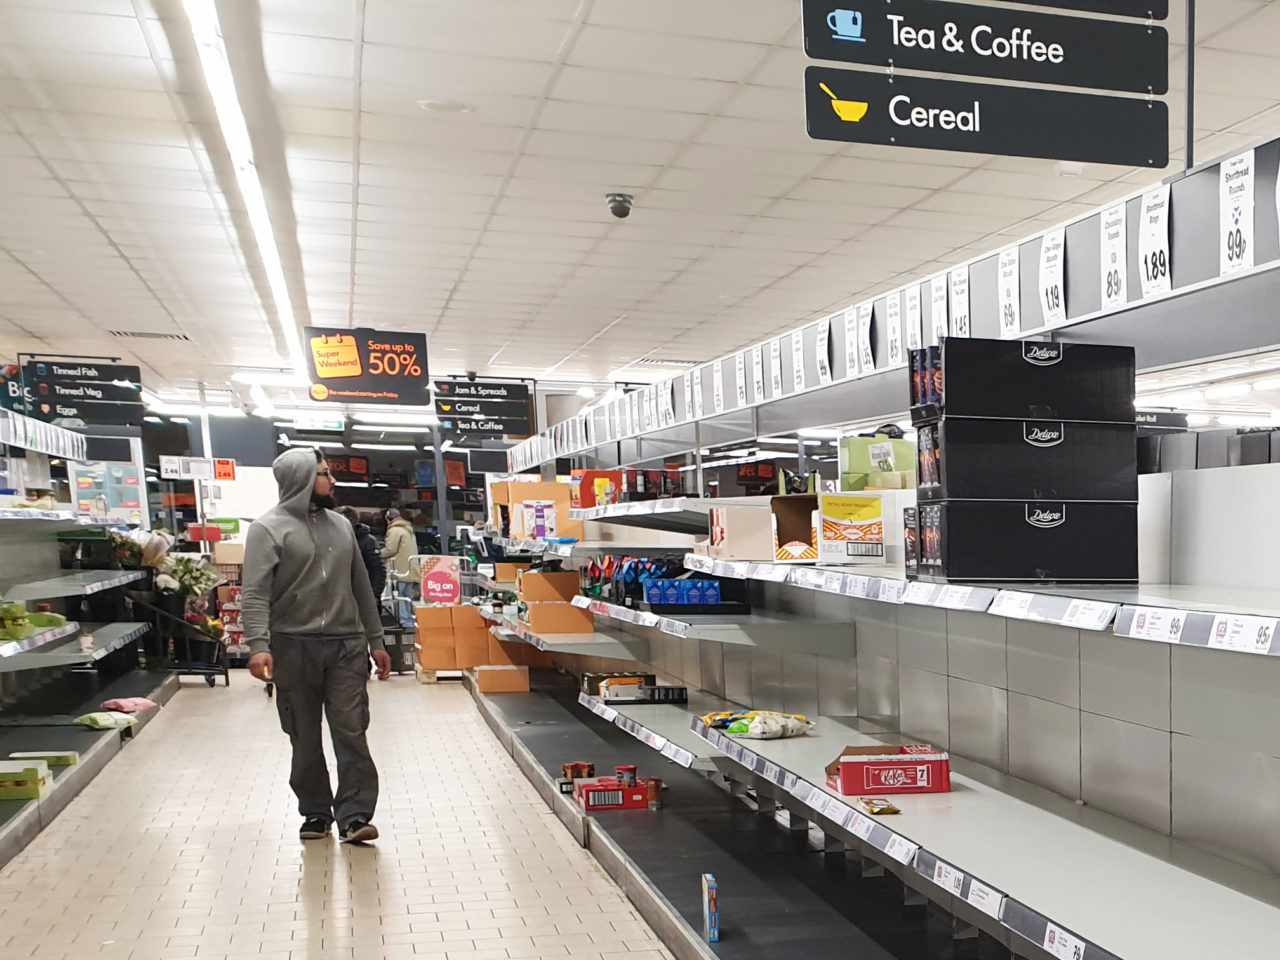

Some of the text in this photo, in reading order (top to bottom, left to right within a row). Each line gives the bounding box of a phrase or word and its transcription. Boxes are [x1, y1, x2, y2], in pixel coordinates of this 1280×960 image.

[886, 14, 1064, 64] Tea & Coffee
[888, 95, 980, 132] Cereal
[1228, 228, 1246, 261] 99p
[1144, 249, 1167, 281] 1.89
[368, 341, 414, 353] Save up to
[1027, 346, 1058, 359] Deluxe
[316, 351, 339, 360] Super
[318, 358, 358, 368] Weekend
[368, 353, 421, 377] 50%
[52, 366, 98, 376] Tinned Fish
[54, 385, 102, 398] Tinned Veg
[455, 386, 469, 394] Jam
[478, 387, 507, 396] Spreads
[56, 405, 78, 416] Eggs
[455, 403, 480, 412] Cereal
[457, 421, 504, 430] Tea & Coffee
[1028, 427, 1060, 440] Deluxe
[1030, 509, 1062, 522] Deluxe
[428, 581, 441, 591] Big
[1256, 626, 1271, 645] 95p
[919, 770, 926, 778] 7
